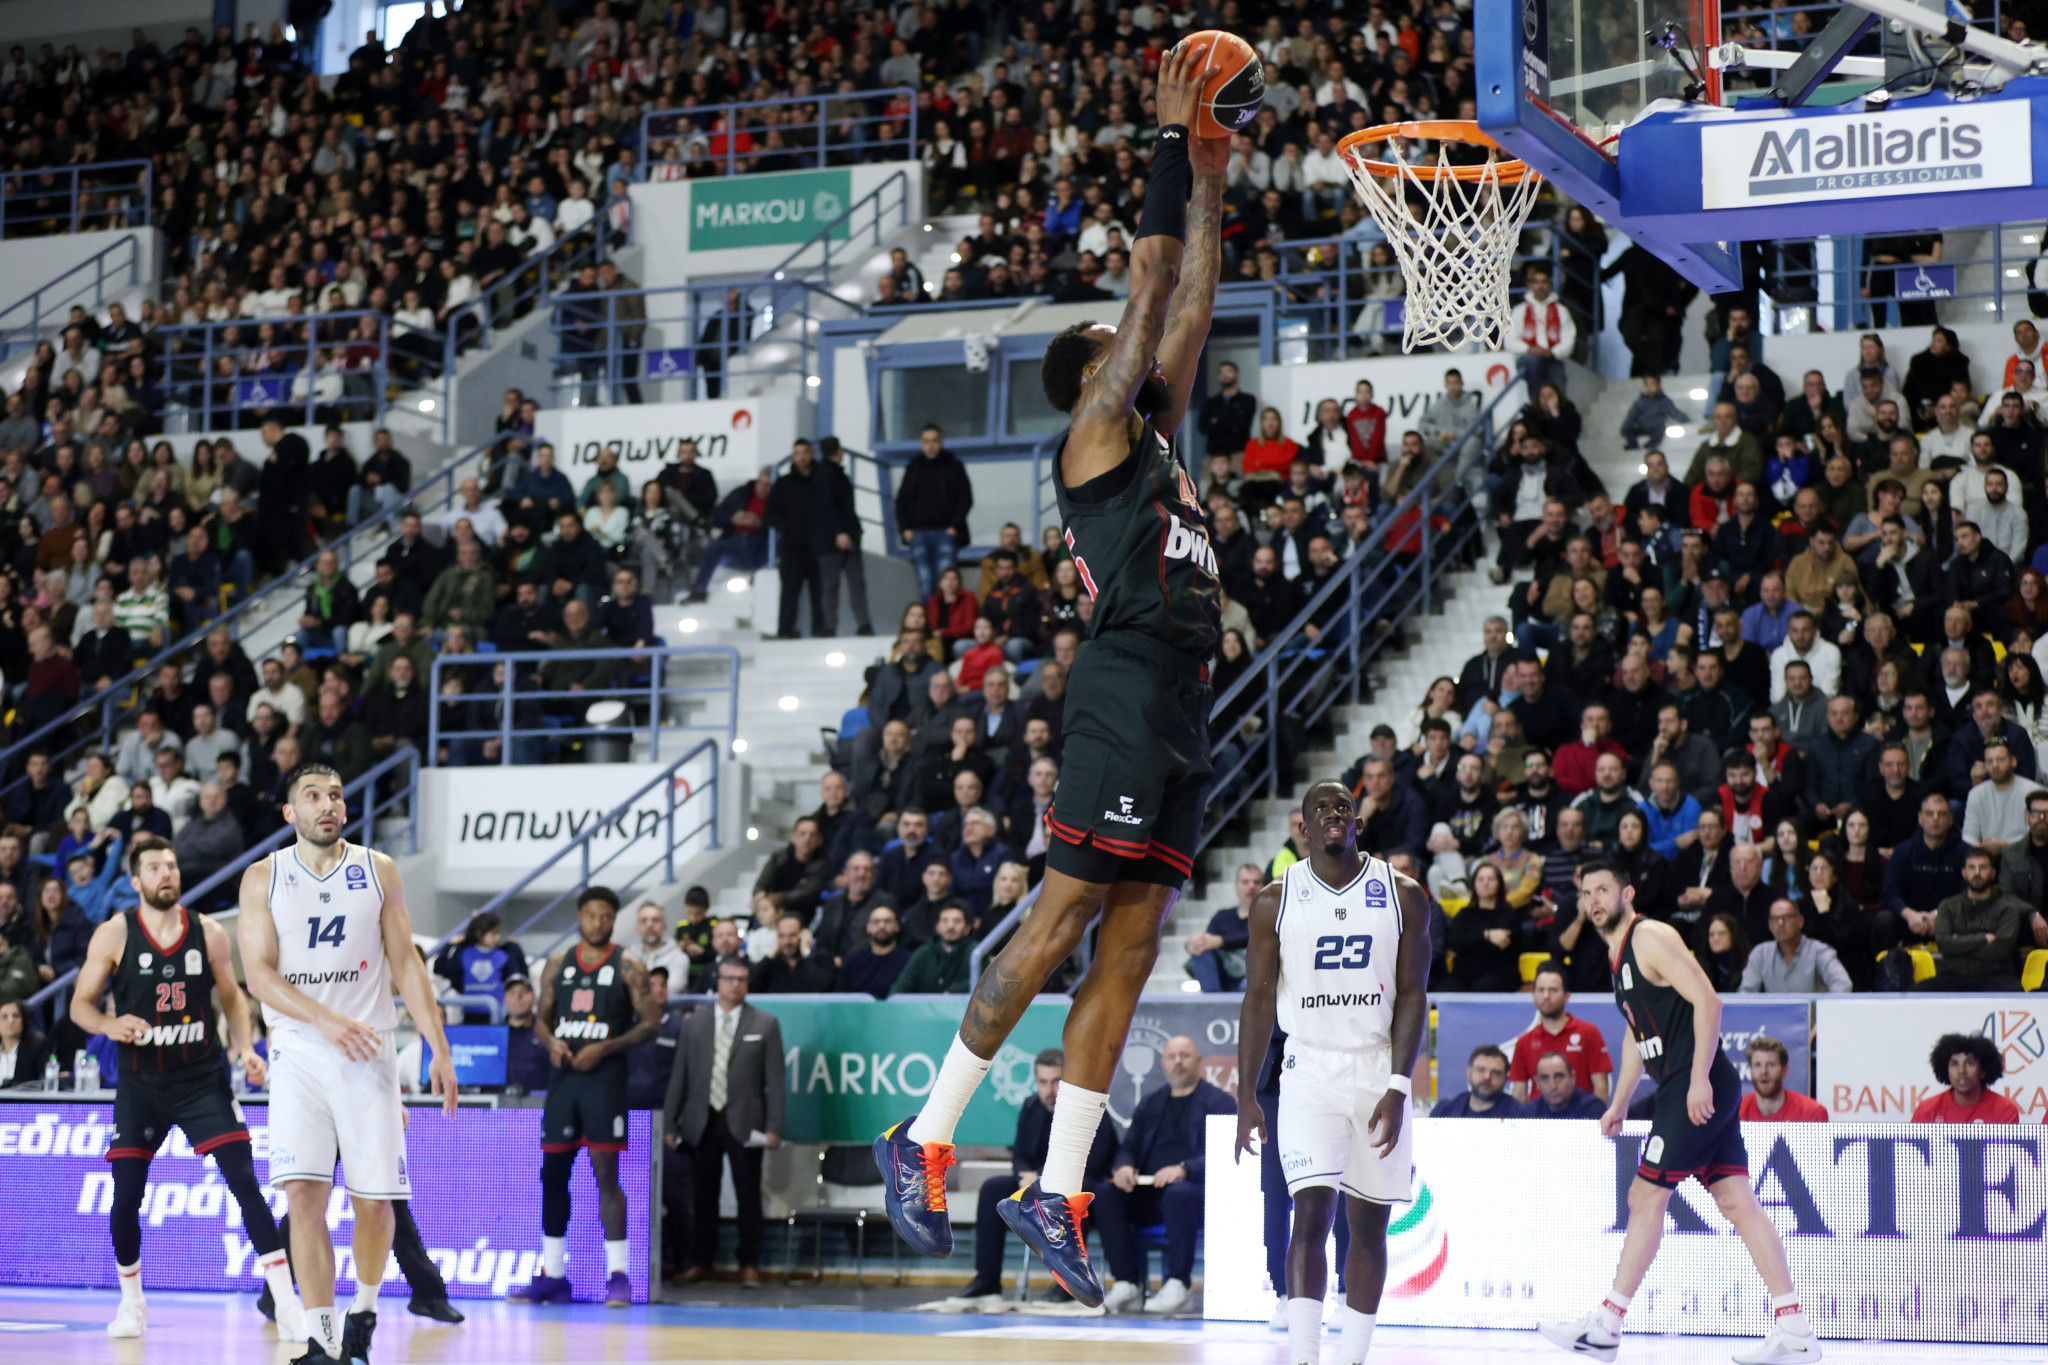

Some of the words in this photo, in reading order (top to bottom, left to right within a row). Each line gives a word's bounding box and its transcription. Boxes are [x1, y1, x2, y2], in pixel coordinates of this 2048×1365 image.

[1749, 117, 1983, 178] Malliaris
[1815, 165, 1976, 190] PROFESSIONAL
[696, 198, 806, 229] MARKOU
[572, 433, 728, 466] ιαπωνκη
[1103, 810, 1143, 825] FlexCar
[307, 915, 347, 949] 14
[1314, 934, 1373, 971] 23
[155, 981, 187, 1013] 25
[785, 1046, 938, 1098] ARKO
[1832, 1084, 1931, 1115] BANK
